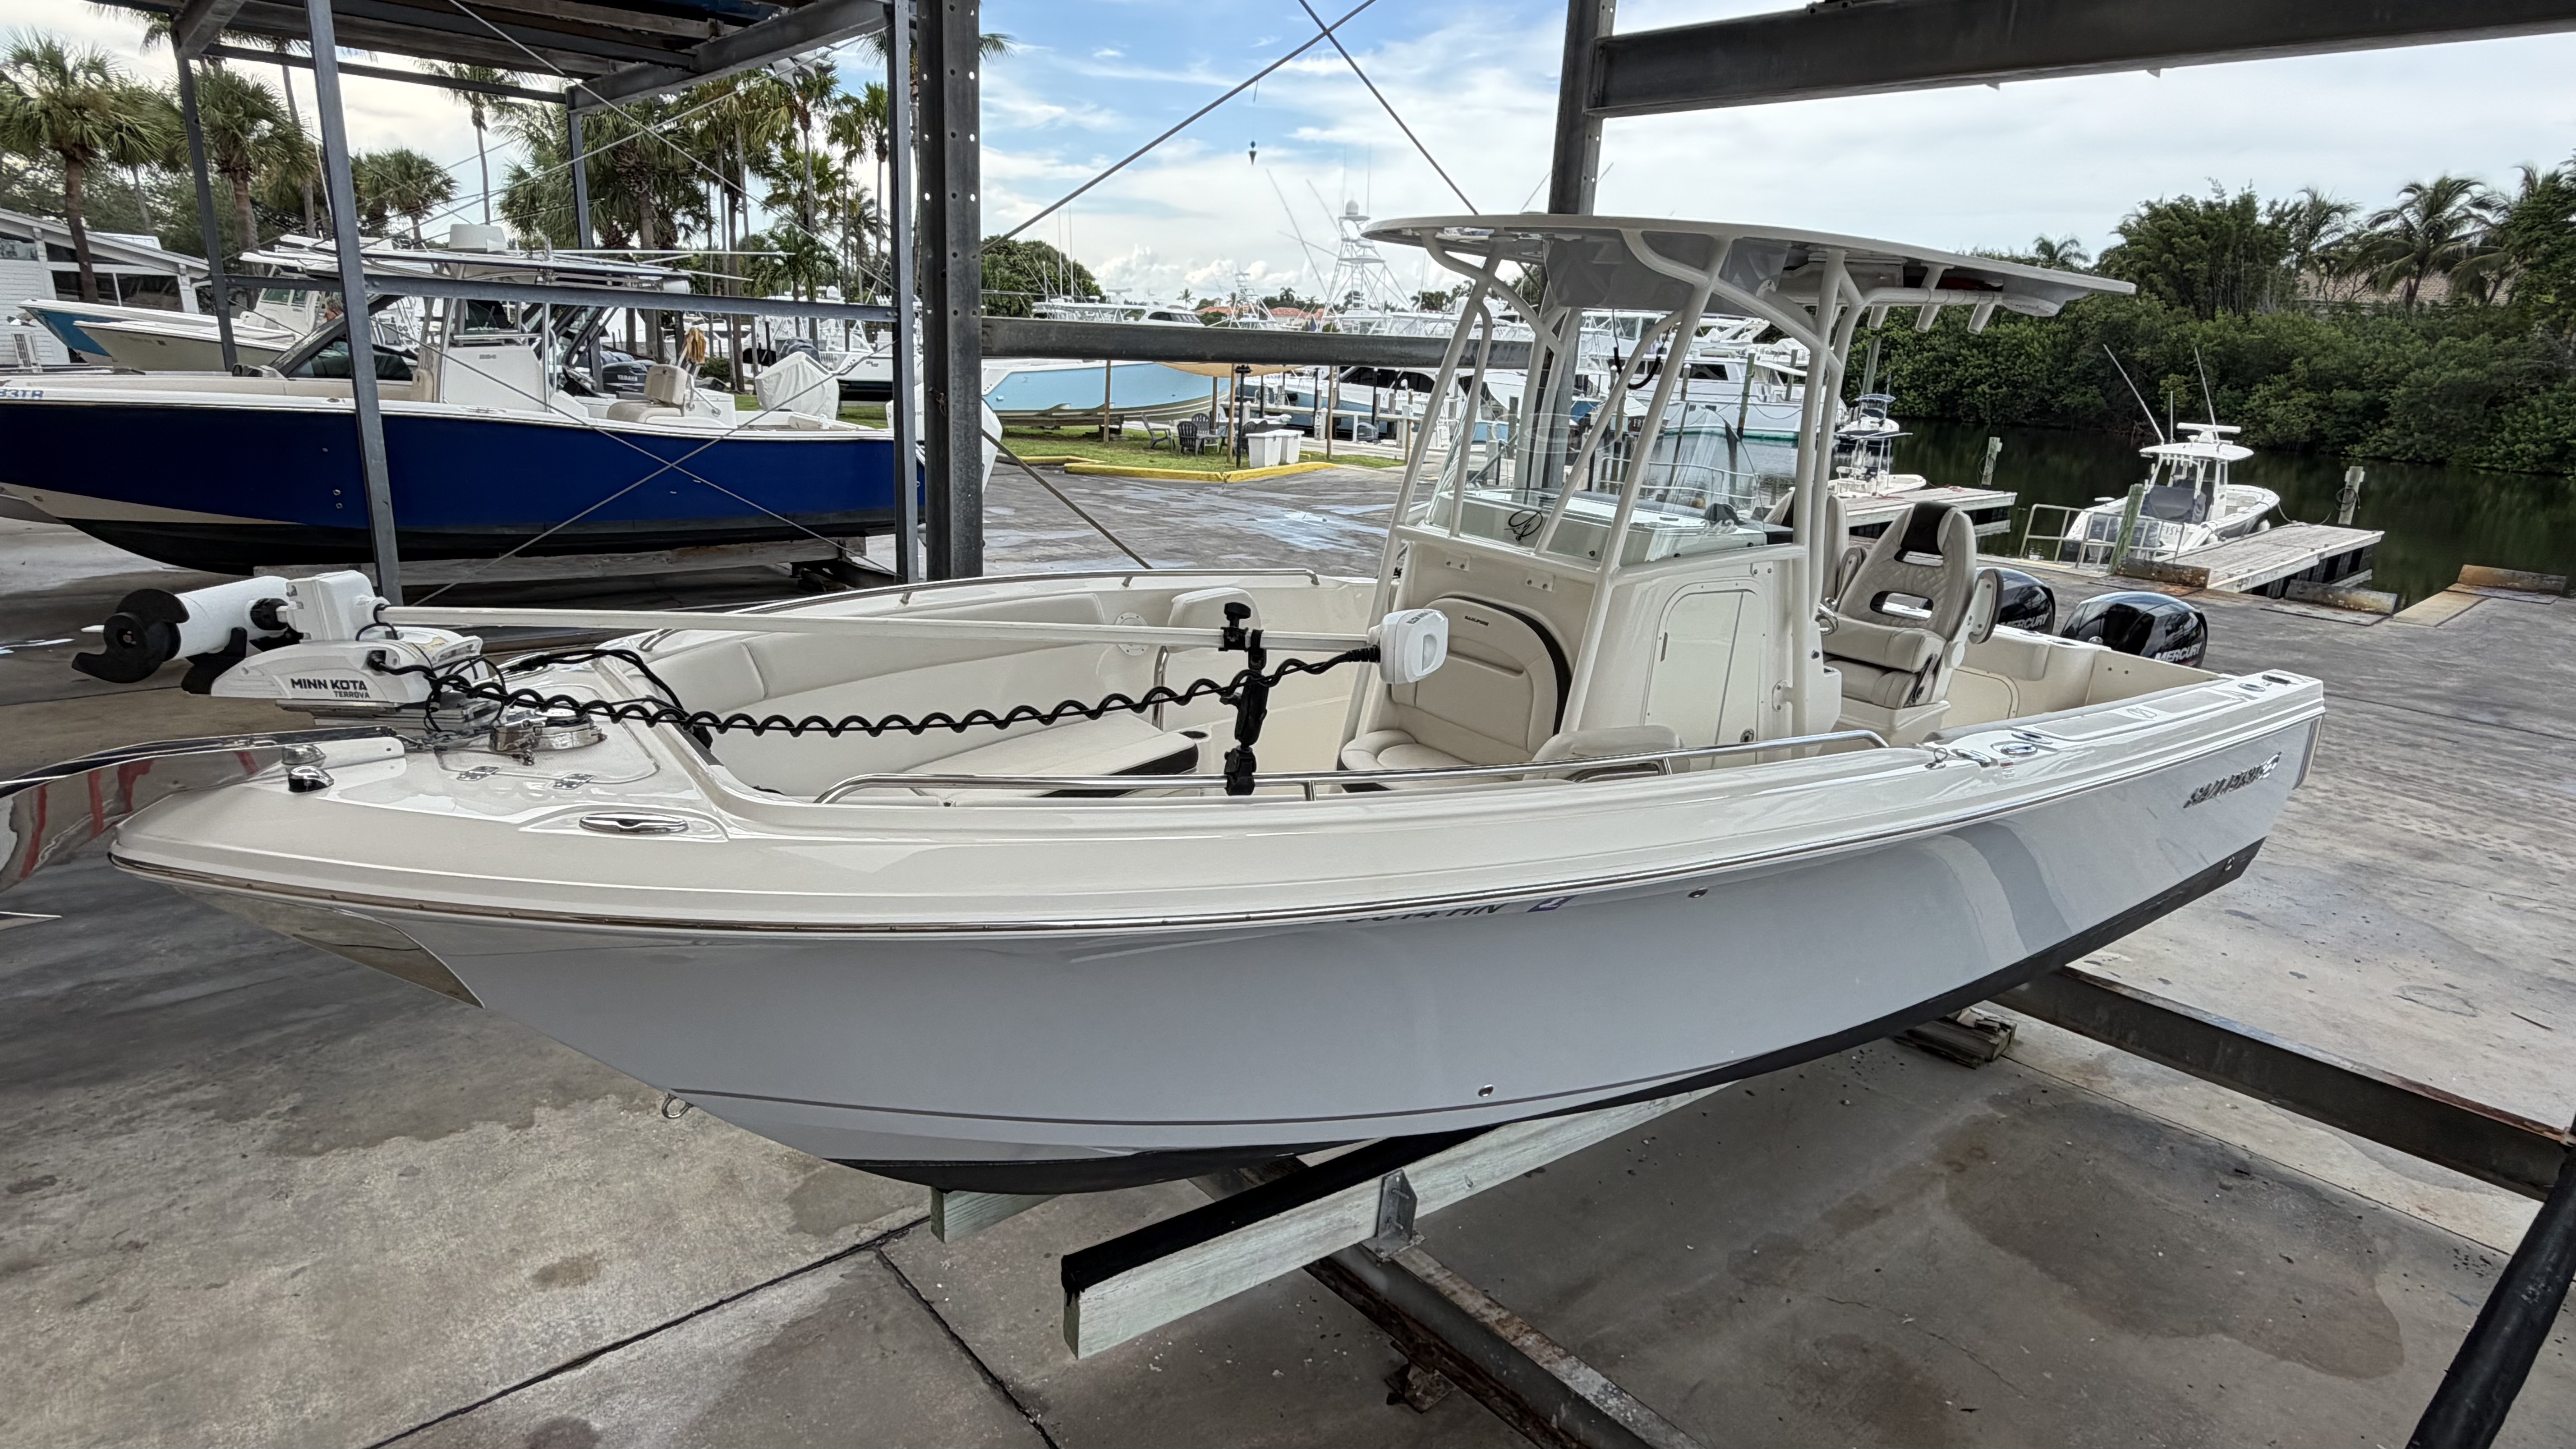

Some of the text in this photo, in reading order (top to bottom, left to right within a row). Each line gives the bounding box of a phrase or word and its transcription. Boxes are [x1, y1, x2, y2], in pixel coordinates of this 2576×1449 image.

[2154, 642, 2203, 662] MERCURY
[290, 678, 368, 691] MINN KOTA
[333, 690, 371, 699] TERROVA
